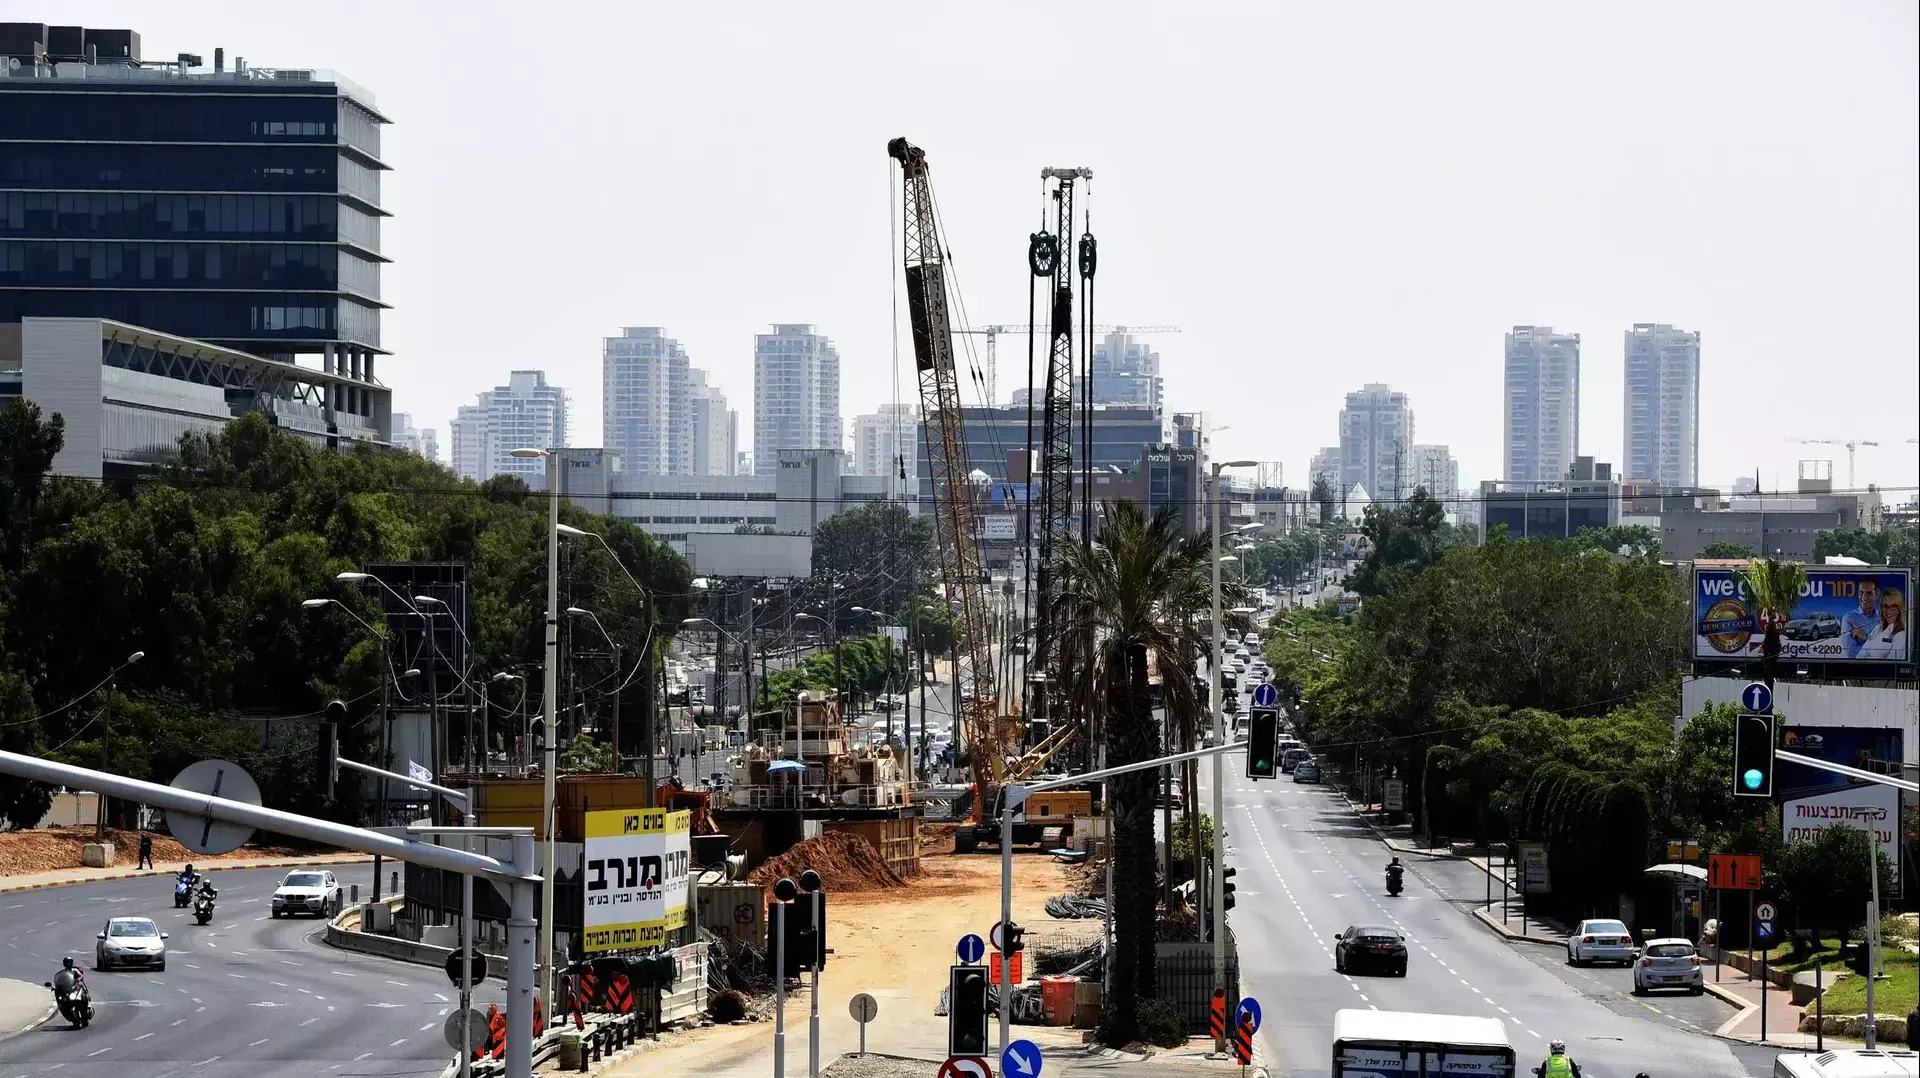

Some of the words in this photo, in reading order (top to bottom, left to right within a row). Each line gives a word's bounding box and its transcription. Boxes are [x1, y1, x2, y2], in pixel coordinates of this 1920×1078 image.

[570, 459, 590, 468] הראל
[1148, 453, 1170, 462] שלמה
[1177, 452, 1194, 461] היכל
[780, 459, 801, 469] הראל
[1702, 578, 1734, 596] we
[1799, 579, 1823, 597] ou
[1779, 643, 1810, 655] dget
[624, 815, 639, 834] כאן
[643, 814, 664, 830] בונים
[588, 855, 662, 891] מנרב
[636, 890, 662, 902] הנדסה
[613, 928, 637, 944] חברות
[640, 925, 664, 942] קבוצת
